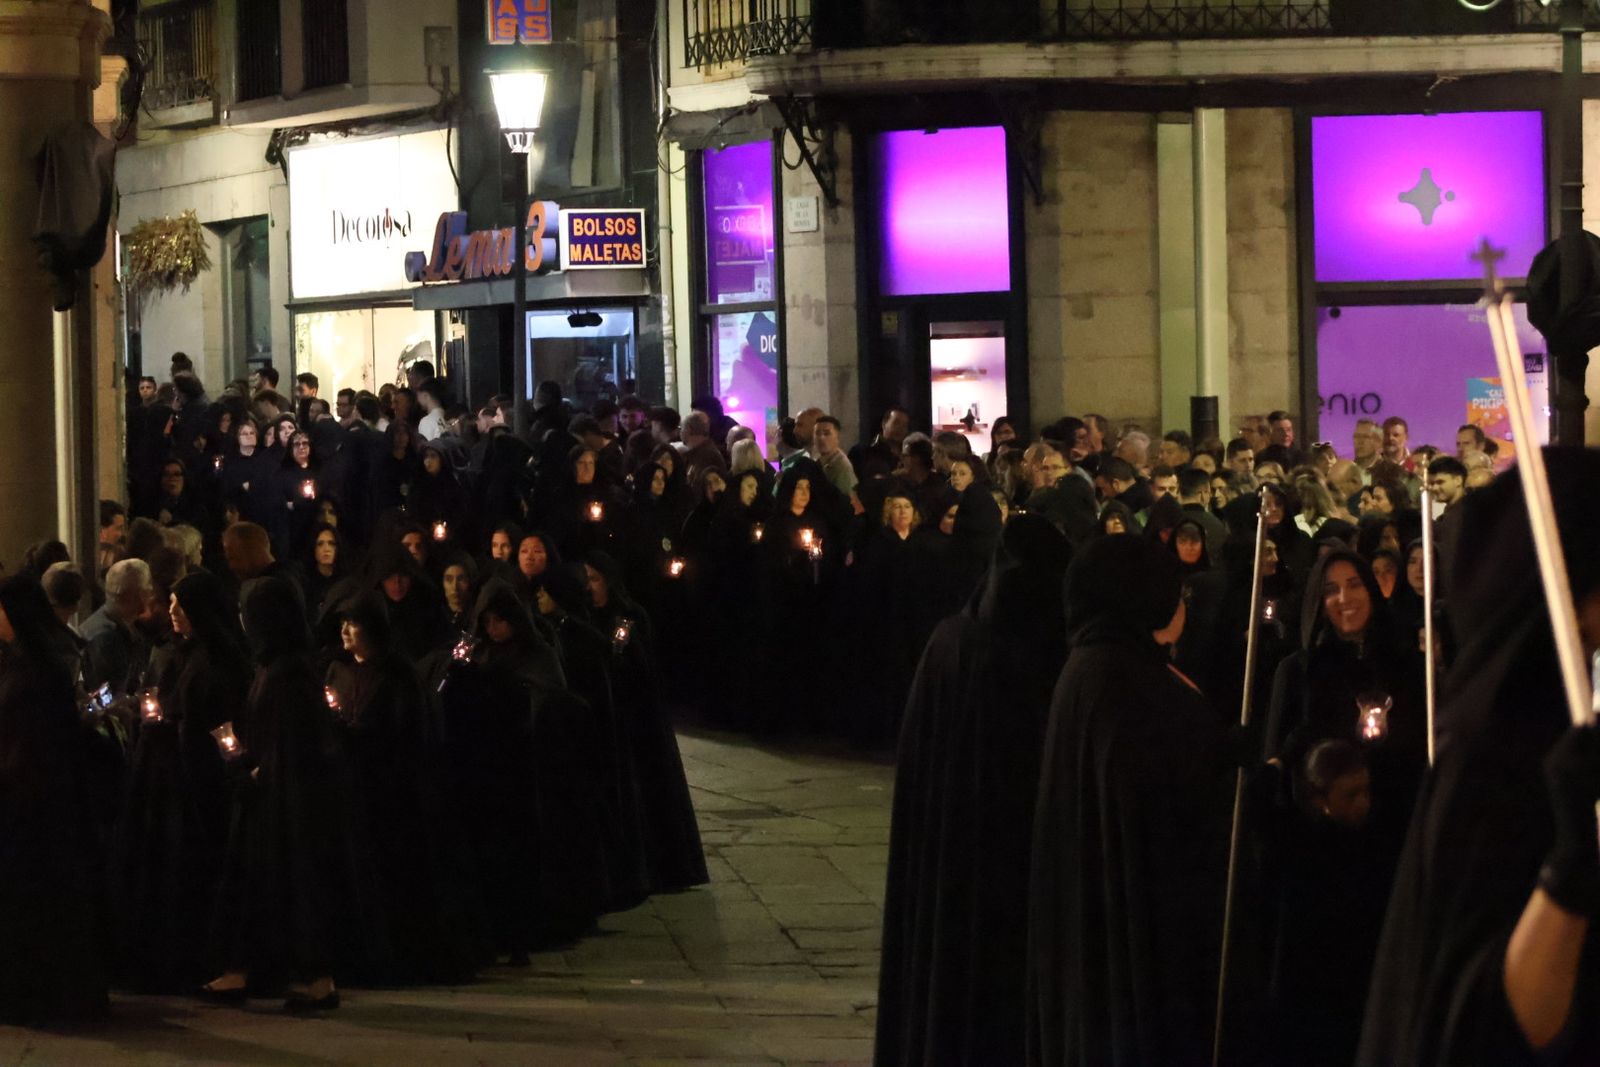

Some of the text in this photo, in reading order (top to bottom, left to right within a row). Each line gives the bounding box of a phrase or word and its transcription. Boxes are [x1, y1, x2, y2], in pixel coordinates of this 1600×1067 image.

[523, 200, 557, 272] 3
[573, 217, 637, 237] BOLSOS
[569, 242, 642, 262] MALETAS
